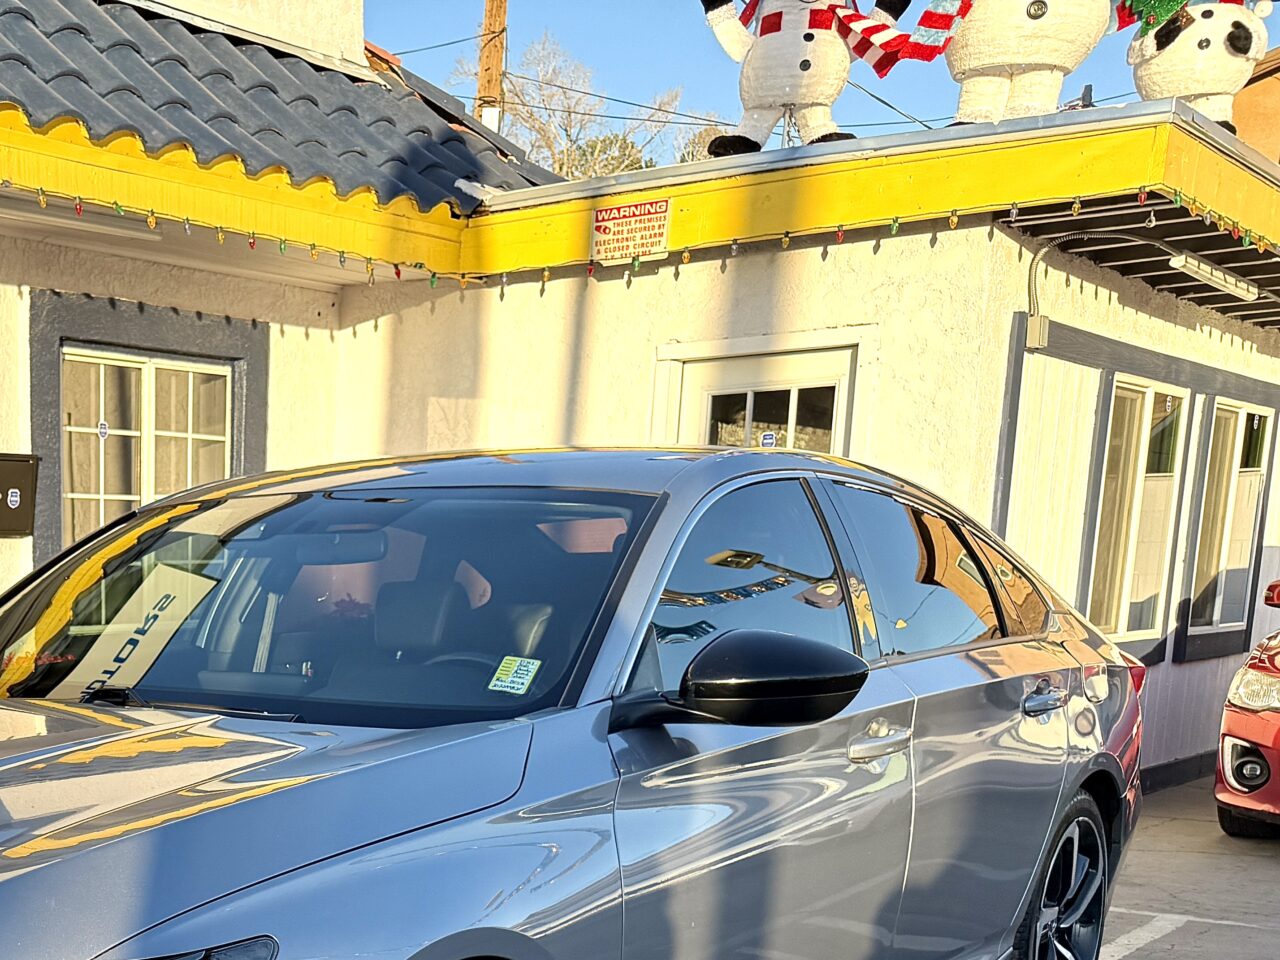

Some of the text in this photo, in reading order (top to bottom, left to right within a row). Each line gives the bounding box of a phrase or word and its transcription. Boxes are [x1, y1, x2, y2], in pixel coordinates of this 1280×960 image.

[597, 201, 668, 221] WARNING
[613, 215, 667, 228] THESE PREMISES
[626, 225, 655, 235] SECURED
[594, 232, 664, 247] ELECTRONIC ALARM
[604, 244, 630, 254] CLOSED
[633, 240, 662, 249] CIRCUIT
